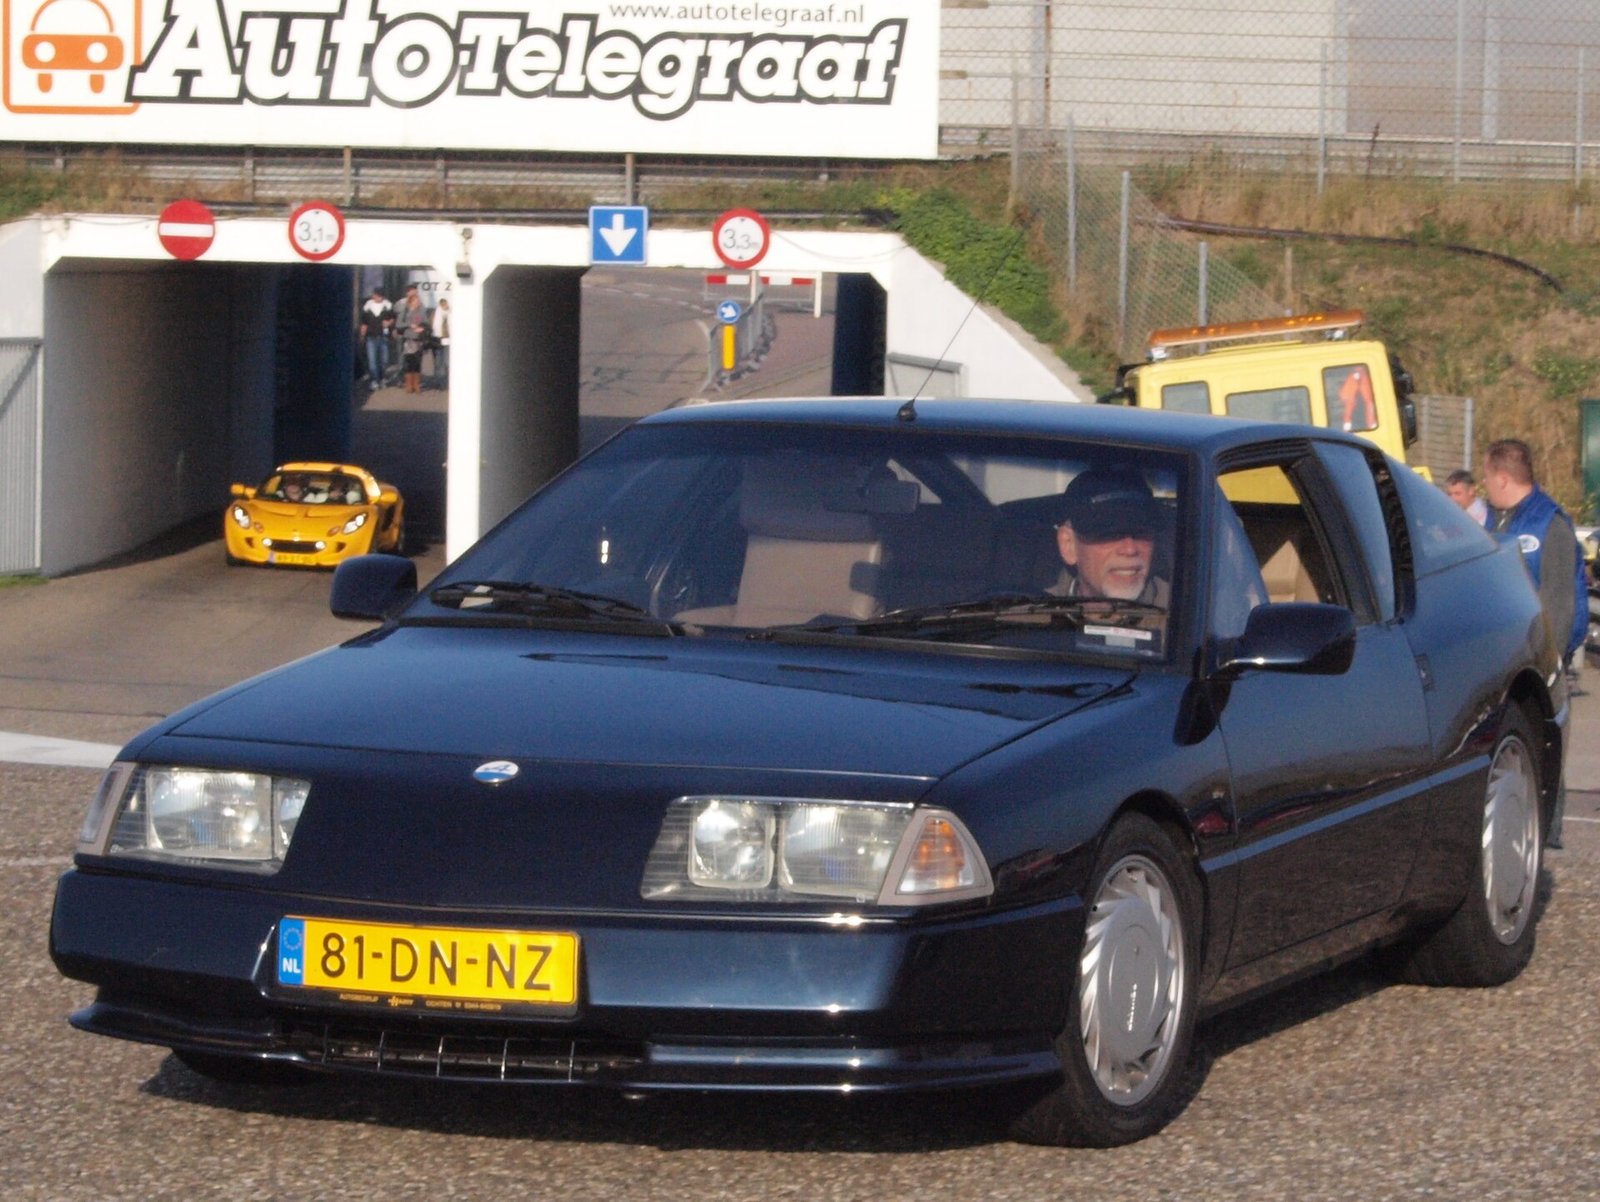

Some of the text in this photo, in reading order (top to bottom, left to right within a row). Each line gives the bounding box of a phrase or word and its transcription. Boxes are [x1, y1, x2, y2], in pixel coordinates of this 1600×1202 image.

[610, 2, 864, 27] www.autotelegraaf.nl
[282, 957, 302, 974] NL
[320, 932, 553, 991] 81-DN-NZ
